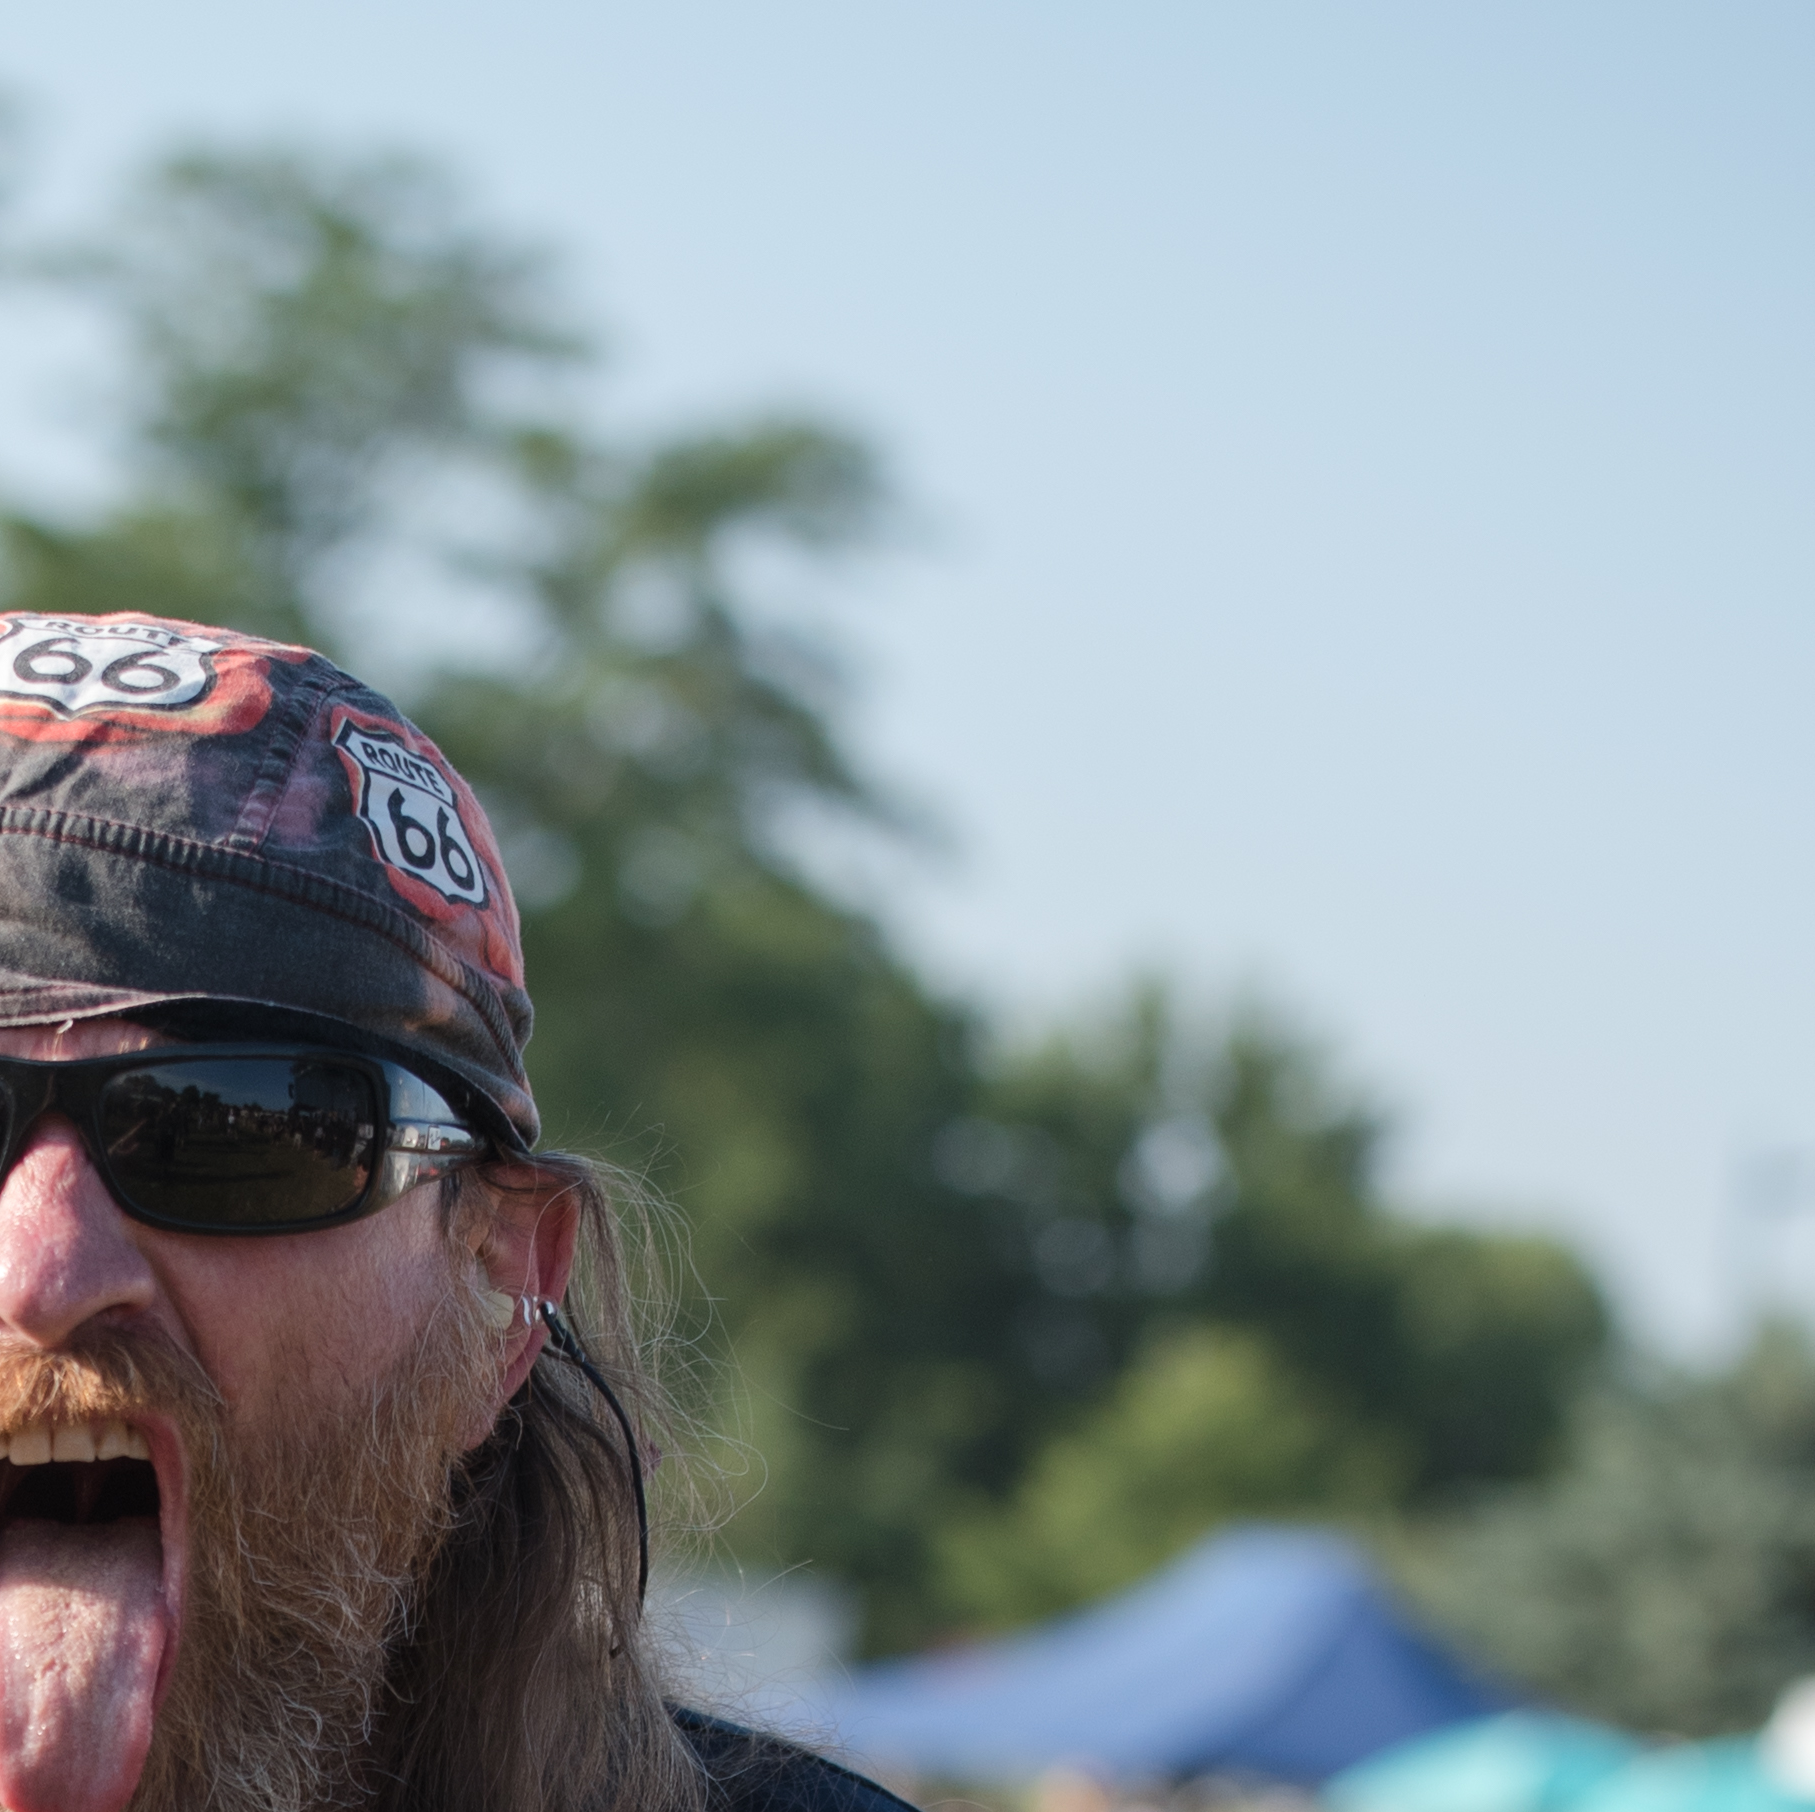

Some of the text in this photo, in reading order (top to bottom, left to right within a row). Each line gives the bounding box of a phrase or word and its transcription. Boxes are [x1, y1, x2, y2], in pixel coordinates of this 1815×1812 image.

[13, 637, 181, 695] 66
[360, 741, 445, 797] ROUTE
[387, 787, 475, 892] 66
